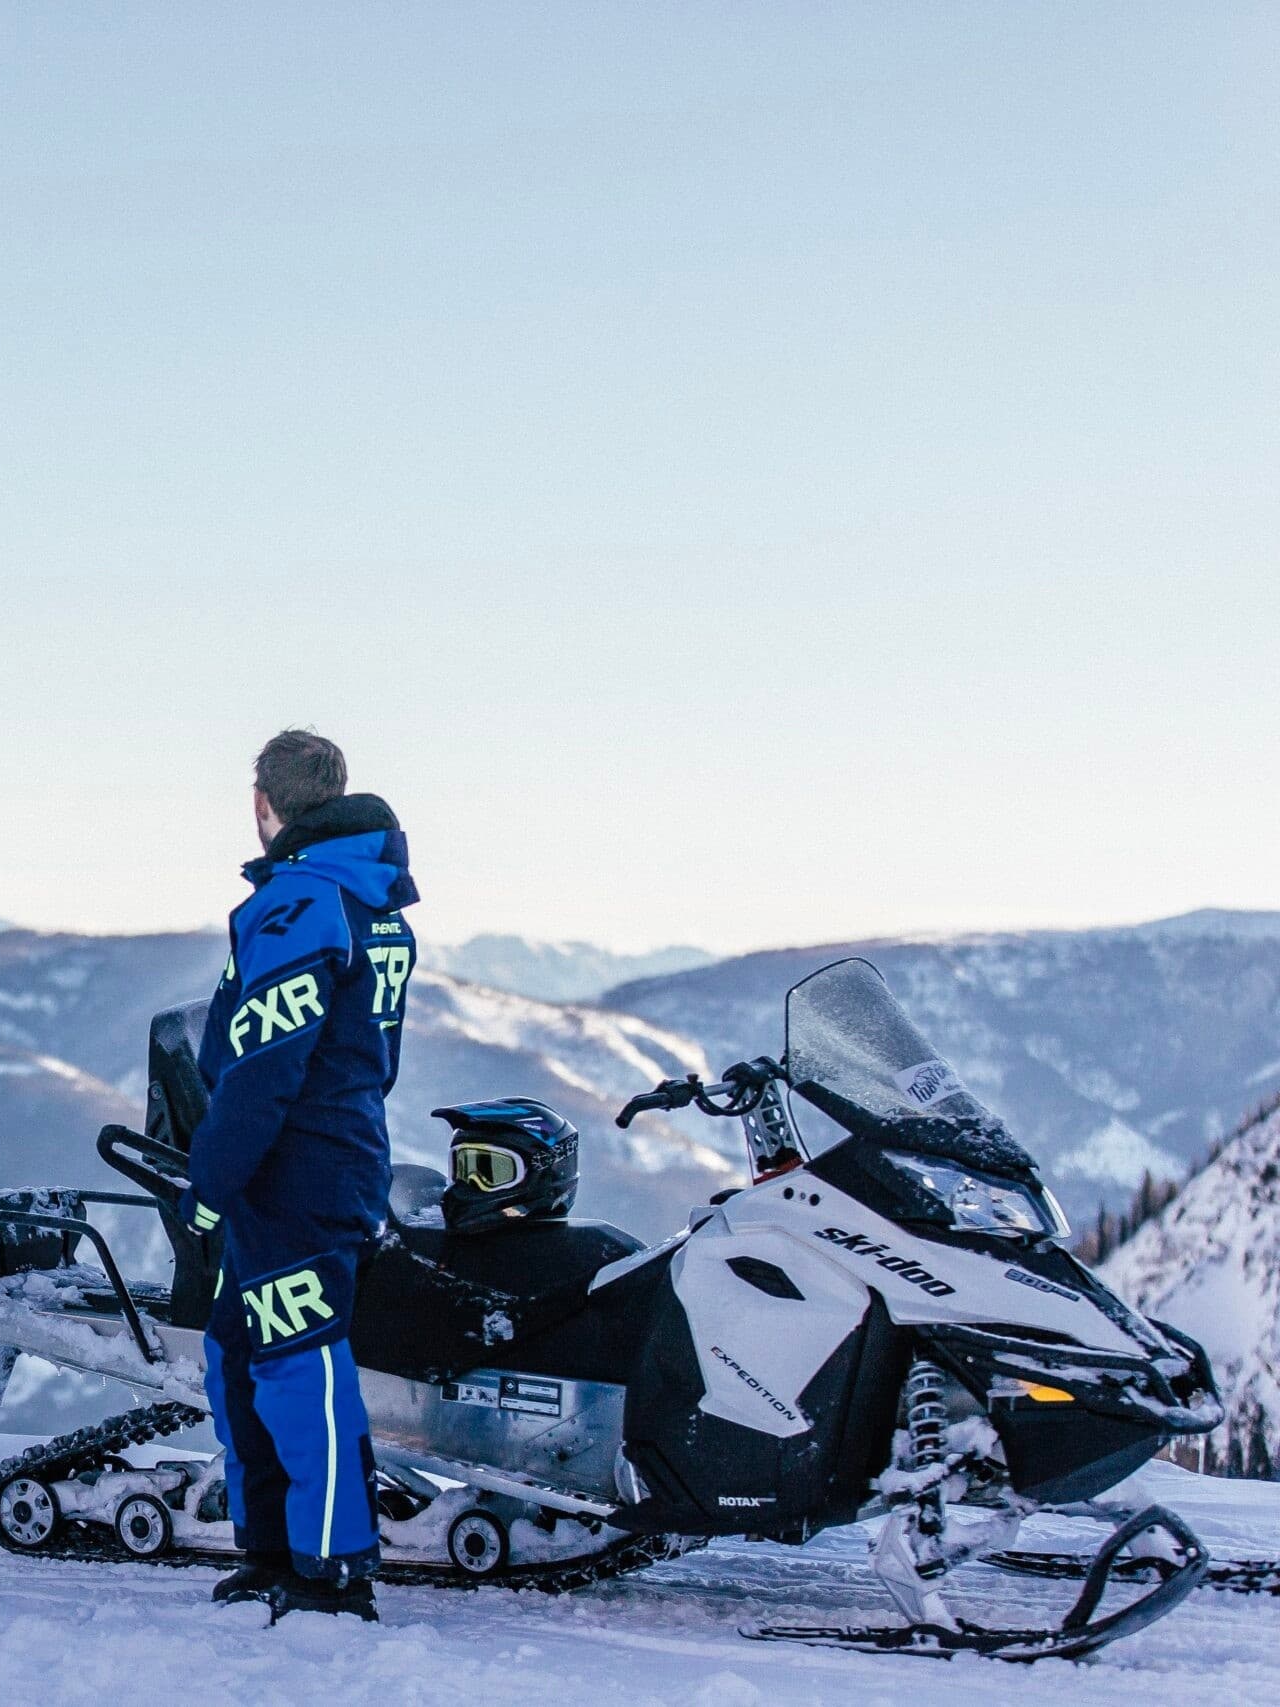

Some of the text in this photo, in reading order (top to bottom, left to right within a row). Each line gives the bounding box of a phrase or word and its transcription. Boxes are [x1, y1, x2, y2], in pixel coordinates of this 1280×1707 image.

[229, 973, 325, 1057] FXR
[242, 1269, 334, 1344] XR
[711, 1346, 797, 1421] EXPEDITION
[719, 1496, 761, 1507] ROTAX
